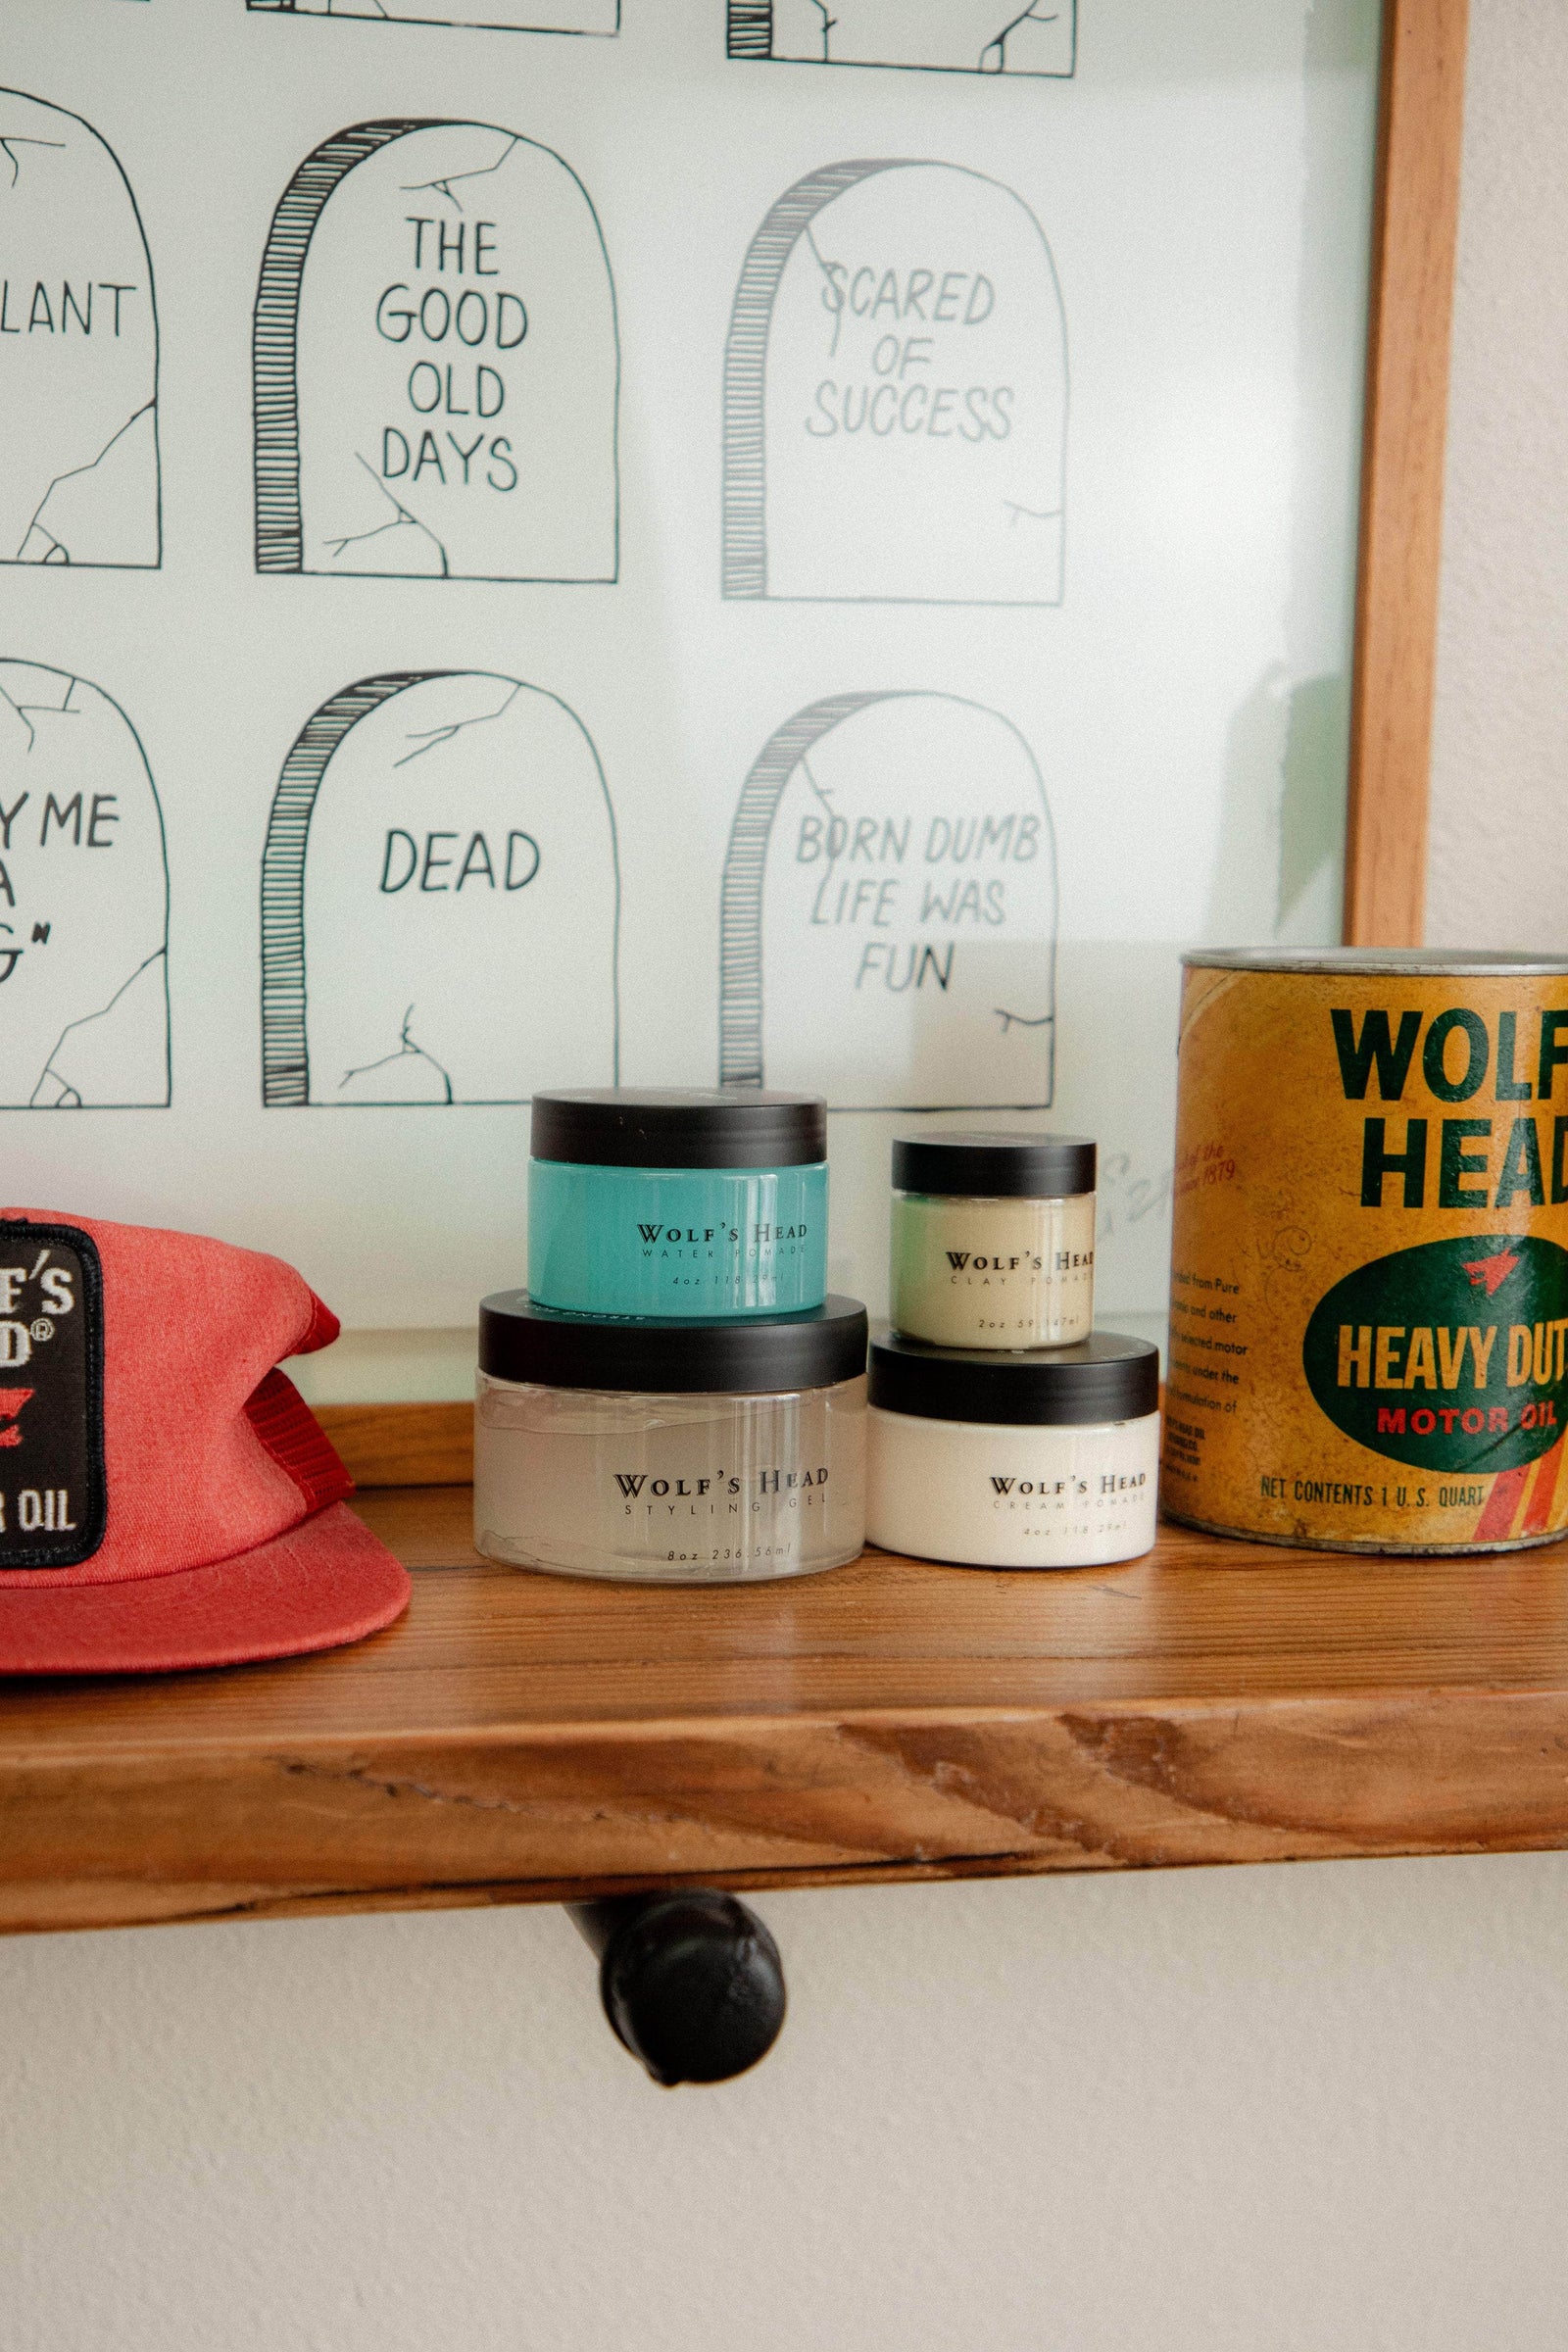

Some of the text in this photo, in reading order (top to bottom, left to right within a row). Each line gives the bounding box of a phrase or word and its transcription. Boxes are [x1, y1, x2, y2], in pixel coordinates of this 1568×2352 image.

[405, 217, 499, 275] THE
[0, 278, 138, 337] LANT
[820, 260, 997, 325] SCARED
[375, 283, 528, 349] GOOD
[871, 334, 934, 380] OF
[408, 359, 505, 418] OLD
[805, 379, 1015, 444] SUCCESS
[381, 426, 518, 492] DAYS
[40, 791, 121, 848] ME
[795, 812, 1043, 864] BORN DUMB
[378, 829, 541, 894] DEAD
[808, 878, 1006, 928] LIFE WAS
[854, 940, 956, 993] FUN
[1201, 1158, 1237, 1187] 1879
[637, 1221, 808, 1245] WOLF'S HEAD
[642, 1246, 807, 1259] WATER POMADE
[946, 1250, 1043, 1272] WOLF'S
[672, 1276, 701, 1286] 4oz
[951, 1275, 1007, 1286] CLAY
[1214, 1277, 1241, 1295] Pure
[978, 1319, 1006, 1329] 2oz
[1208, 1307, 1238, 1324] other
[1214, 1340, 1250, 1356] motor
[1337, 1324, 1499, 1391] HEAVY
[1221, 1369, 1240, 1385] the
[1376, 1398, 1558, 1436] MOTOR OIL
[612, 1467, 829, 1499] WOLF'S HEAD
[989, 1474, 1090, 1495] WOLF'S
[1101, 1472, 1148, 1494] HEAD
[1259, 1475, 1287, 1499] NET
[1293, 1479, 1374, 1507] CONTENTS
[1381, 1486, 1389, 1507] 1
[1438, 1485, 1485, 1507] QUART
[18, 1489, 77, 1532] OIL
[624, 1493, 826, 1516] STYLING GEL
[993, 1500, 1066, 1510] CREAM
[667, 1550, 698, 1561] 8oz
